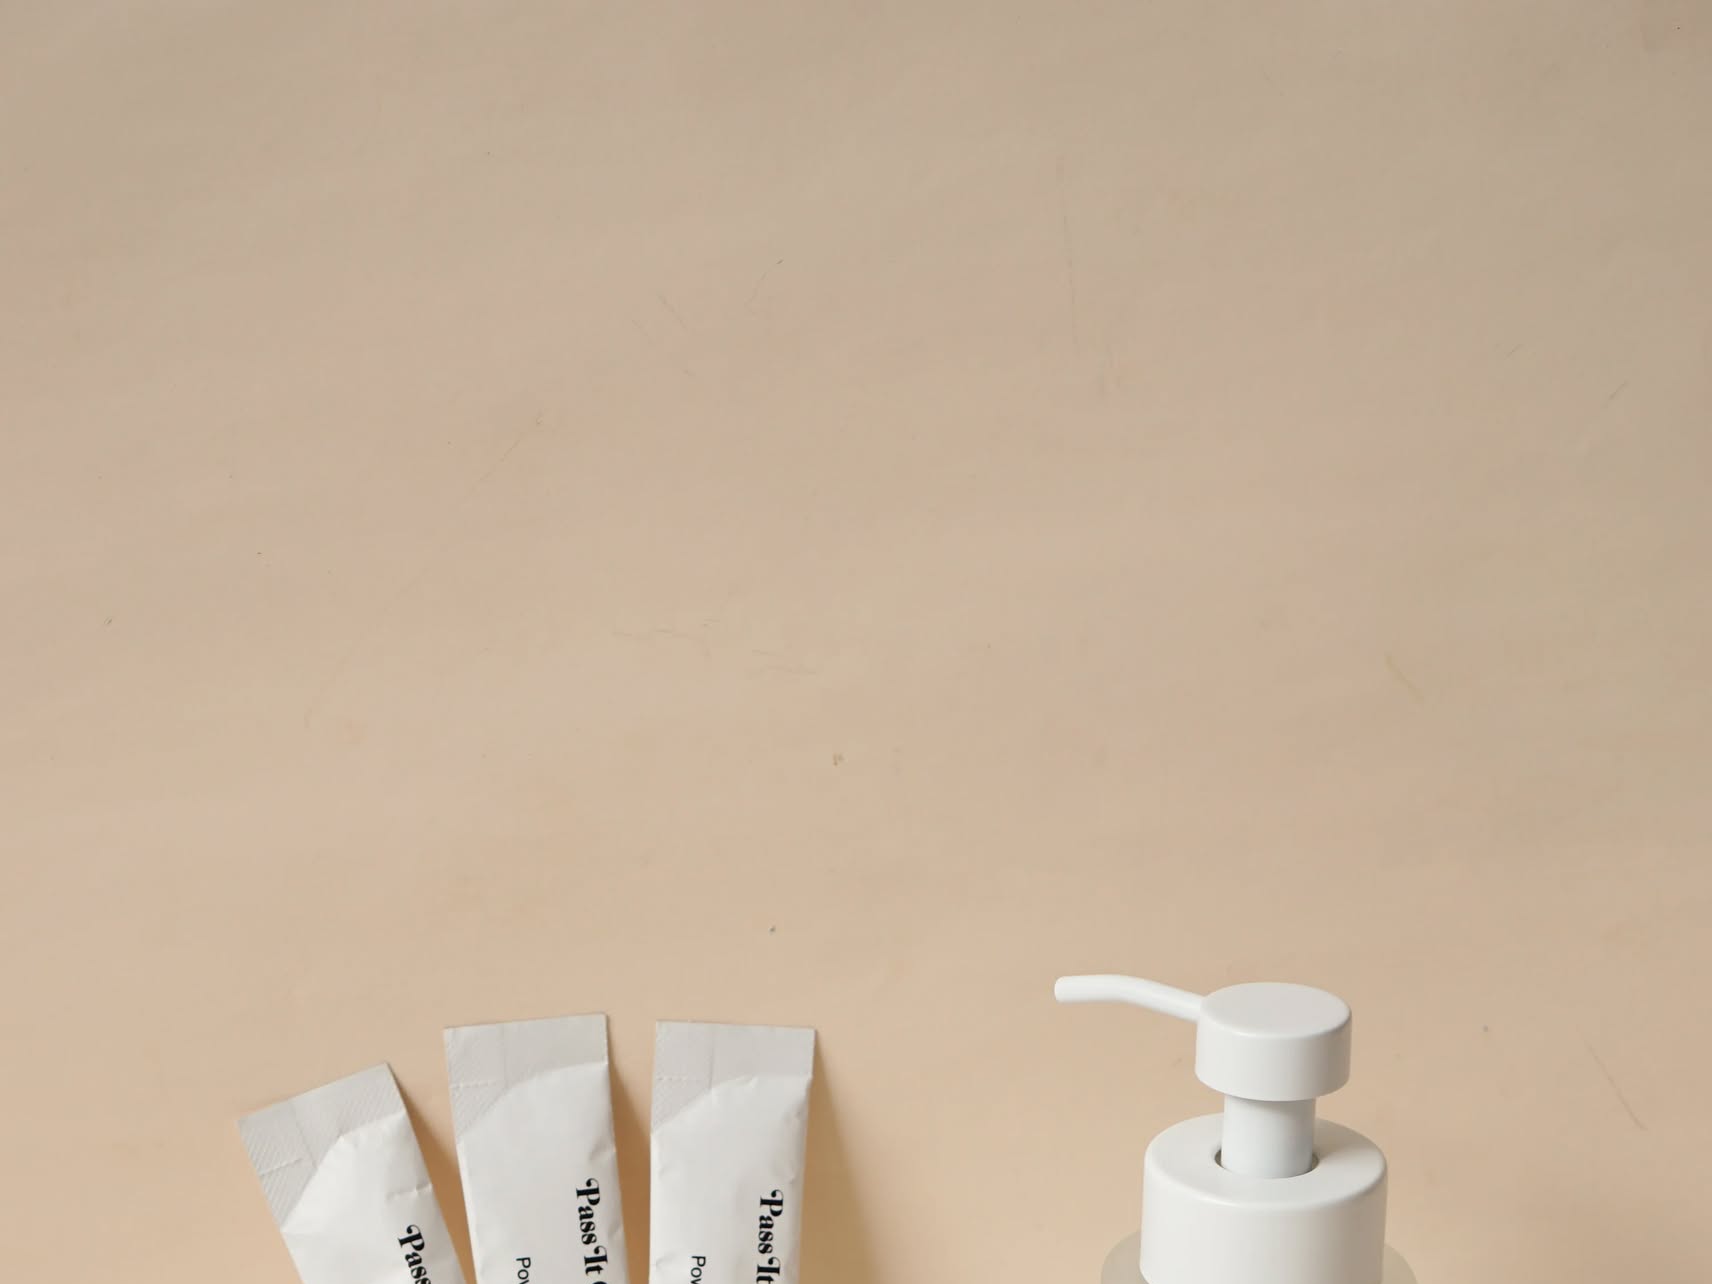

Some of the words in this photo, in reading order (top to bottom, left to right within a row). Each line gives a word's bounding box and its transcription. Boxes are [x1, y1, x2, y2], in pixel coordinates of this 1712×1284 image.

[576, 1178, 601, 1245] Pass
[758, 1189, 784, 1255] Pass
[584, 1245, 608, 1276] It
[756, 1256, 781, 1284] It
